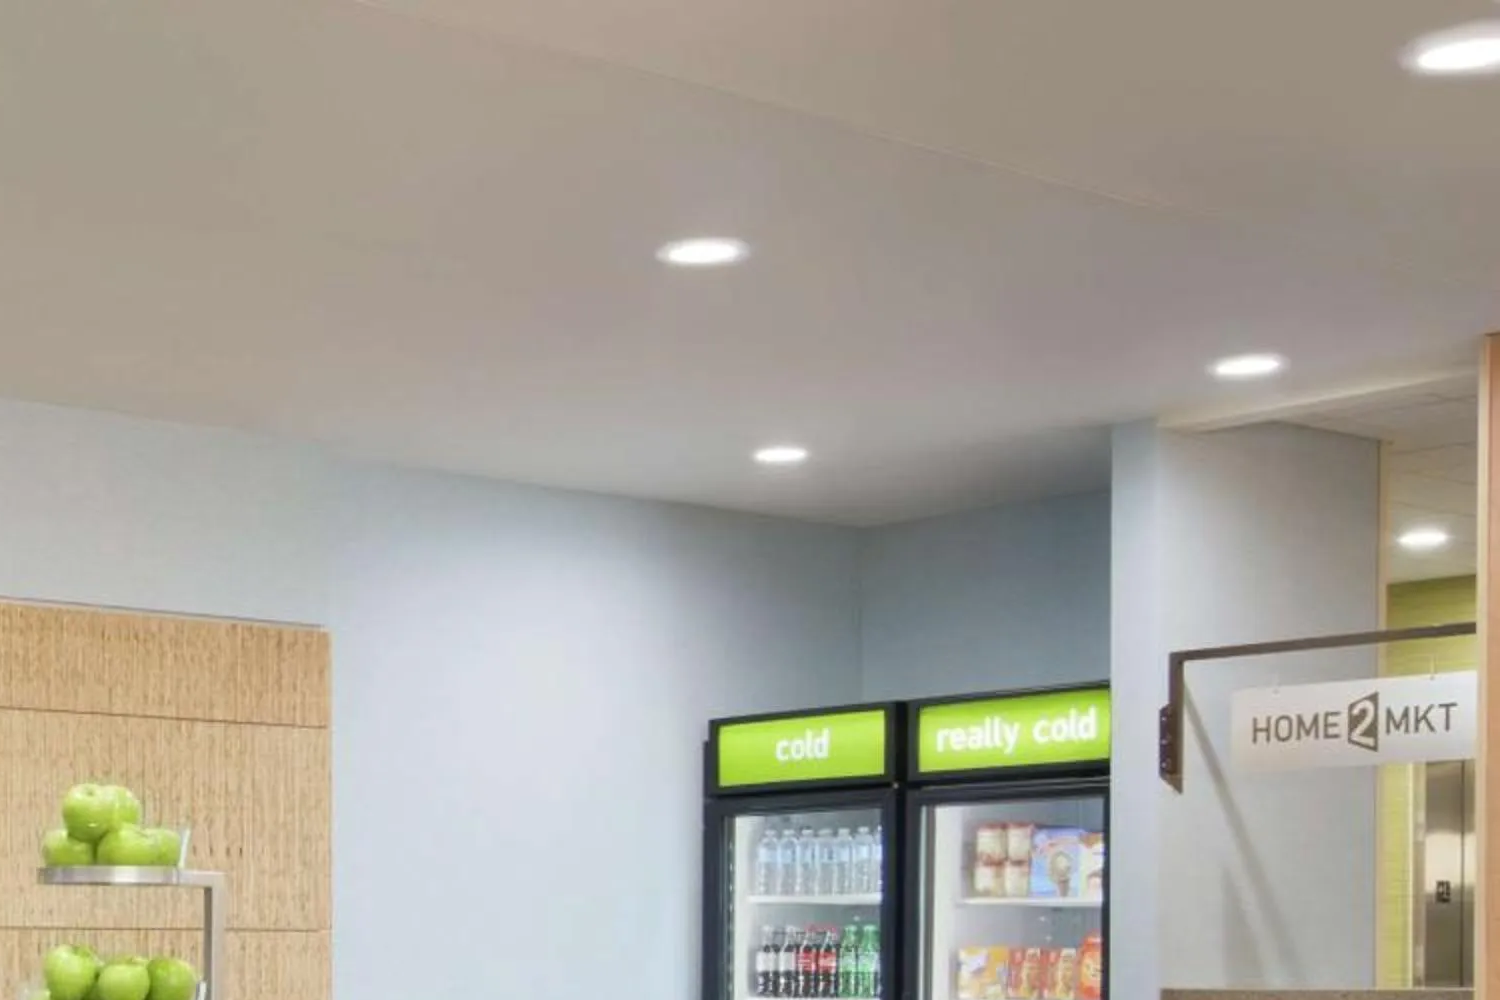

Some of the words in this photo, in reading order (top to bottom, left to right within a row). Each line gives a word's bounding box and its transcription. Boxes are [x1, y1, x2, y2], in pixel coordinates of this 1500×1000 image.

[775, 727, 830, 763] cold
[935, 715, 1020, 754] really
[1032, 703, 1098, 744] cold
[1252, 711, 1341, 744] HOME
[1349, 699, 1376, 747] 2
[1385, 702, 1458, 734] MKT
